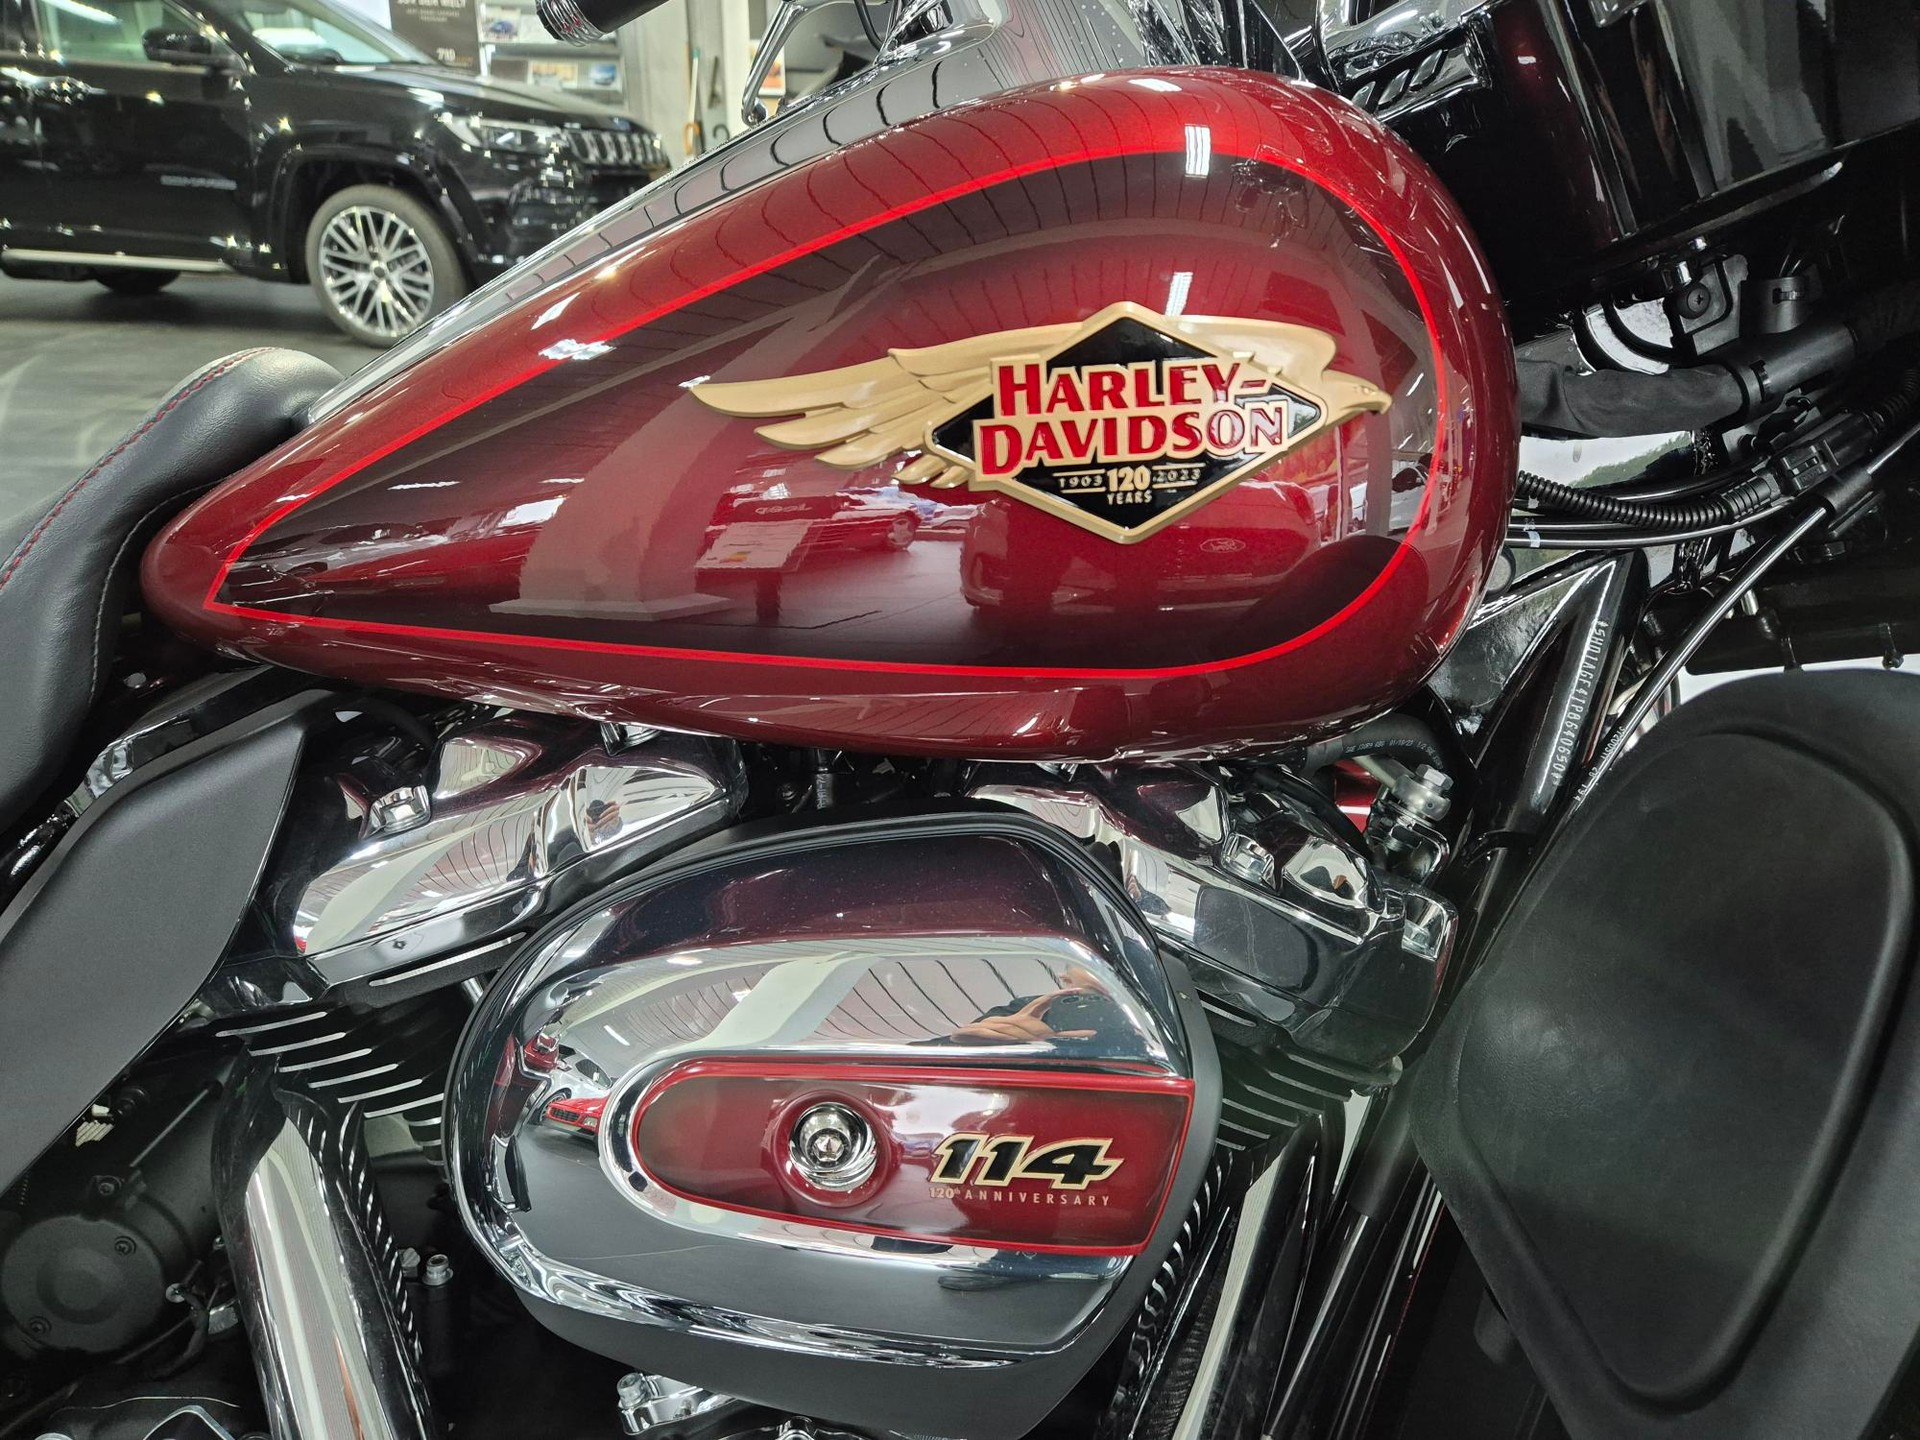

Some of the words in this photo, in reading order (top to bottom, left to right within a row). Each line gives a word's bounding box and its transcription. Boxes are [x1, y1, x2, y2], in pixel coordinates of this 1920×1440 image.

[997, 361, 1268, 418] HARLEY-
[978, 405, 1285, 476] DAVIDSON
[1058, 474, 1103, 490] 1903
[1106, 465, 1151, 492] 120
[1156, 468, 1201, 485] 2023
[1106, 489, 1153, 506] YEARS
[928, 1131, 1124, 1190] 114
[965, 1190, 1110, 1207] ANNIVERSARY
